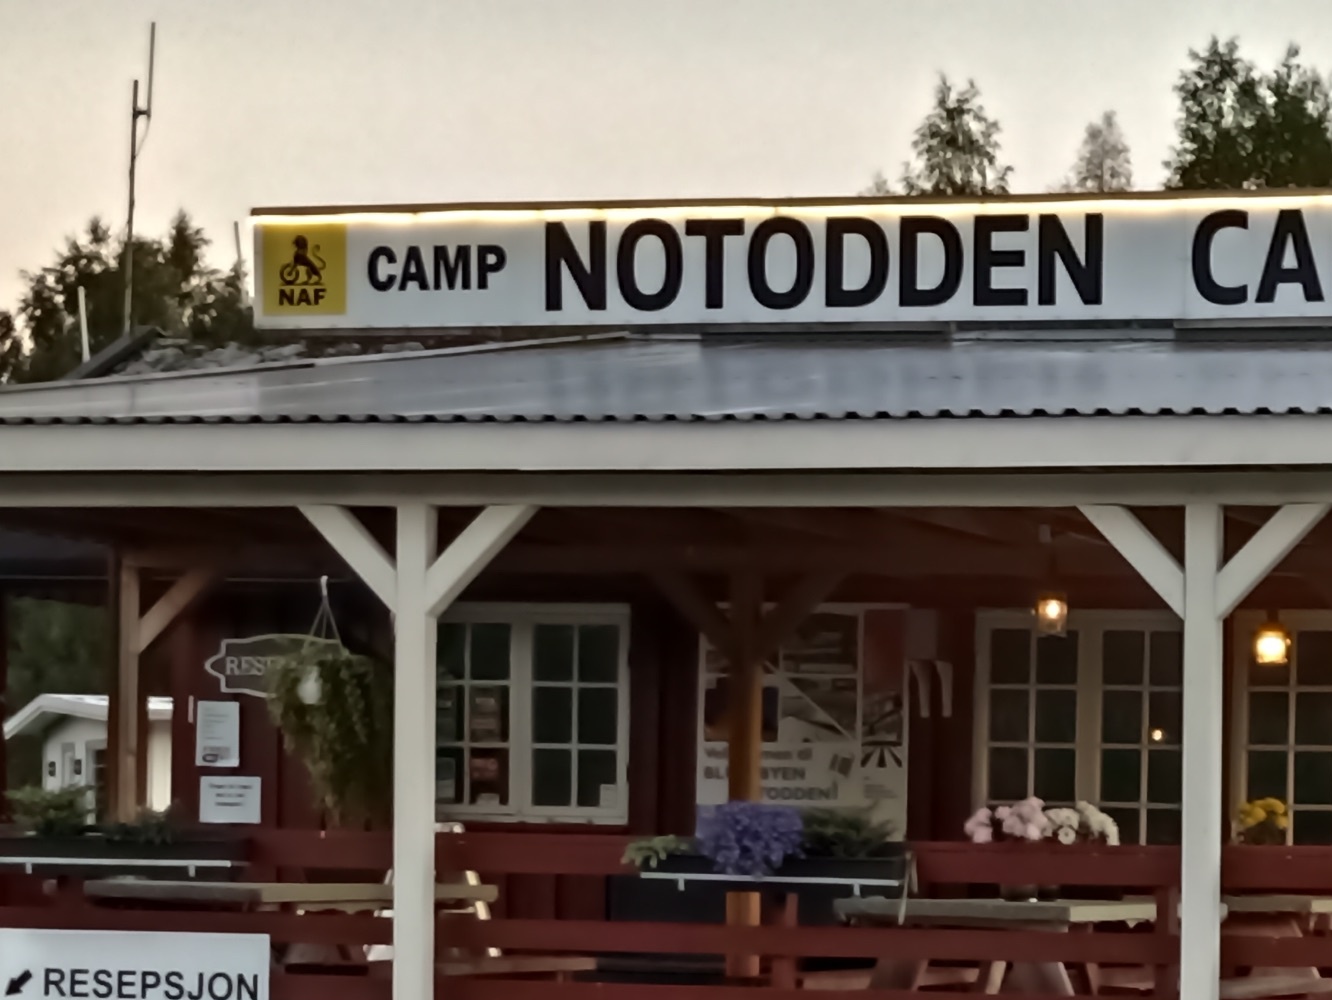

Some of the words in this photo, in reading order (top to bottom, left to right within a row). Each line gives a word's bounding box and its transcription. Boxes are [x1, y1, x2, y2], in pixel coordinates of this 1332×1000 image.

[367, 243, 507, 293] CAMP
[545, 212, 1104, 312] NOTODDEN
[278, 288, 328, 307] NAF
